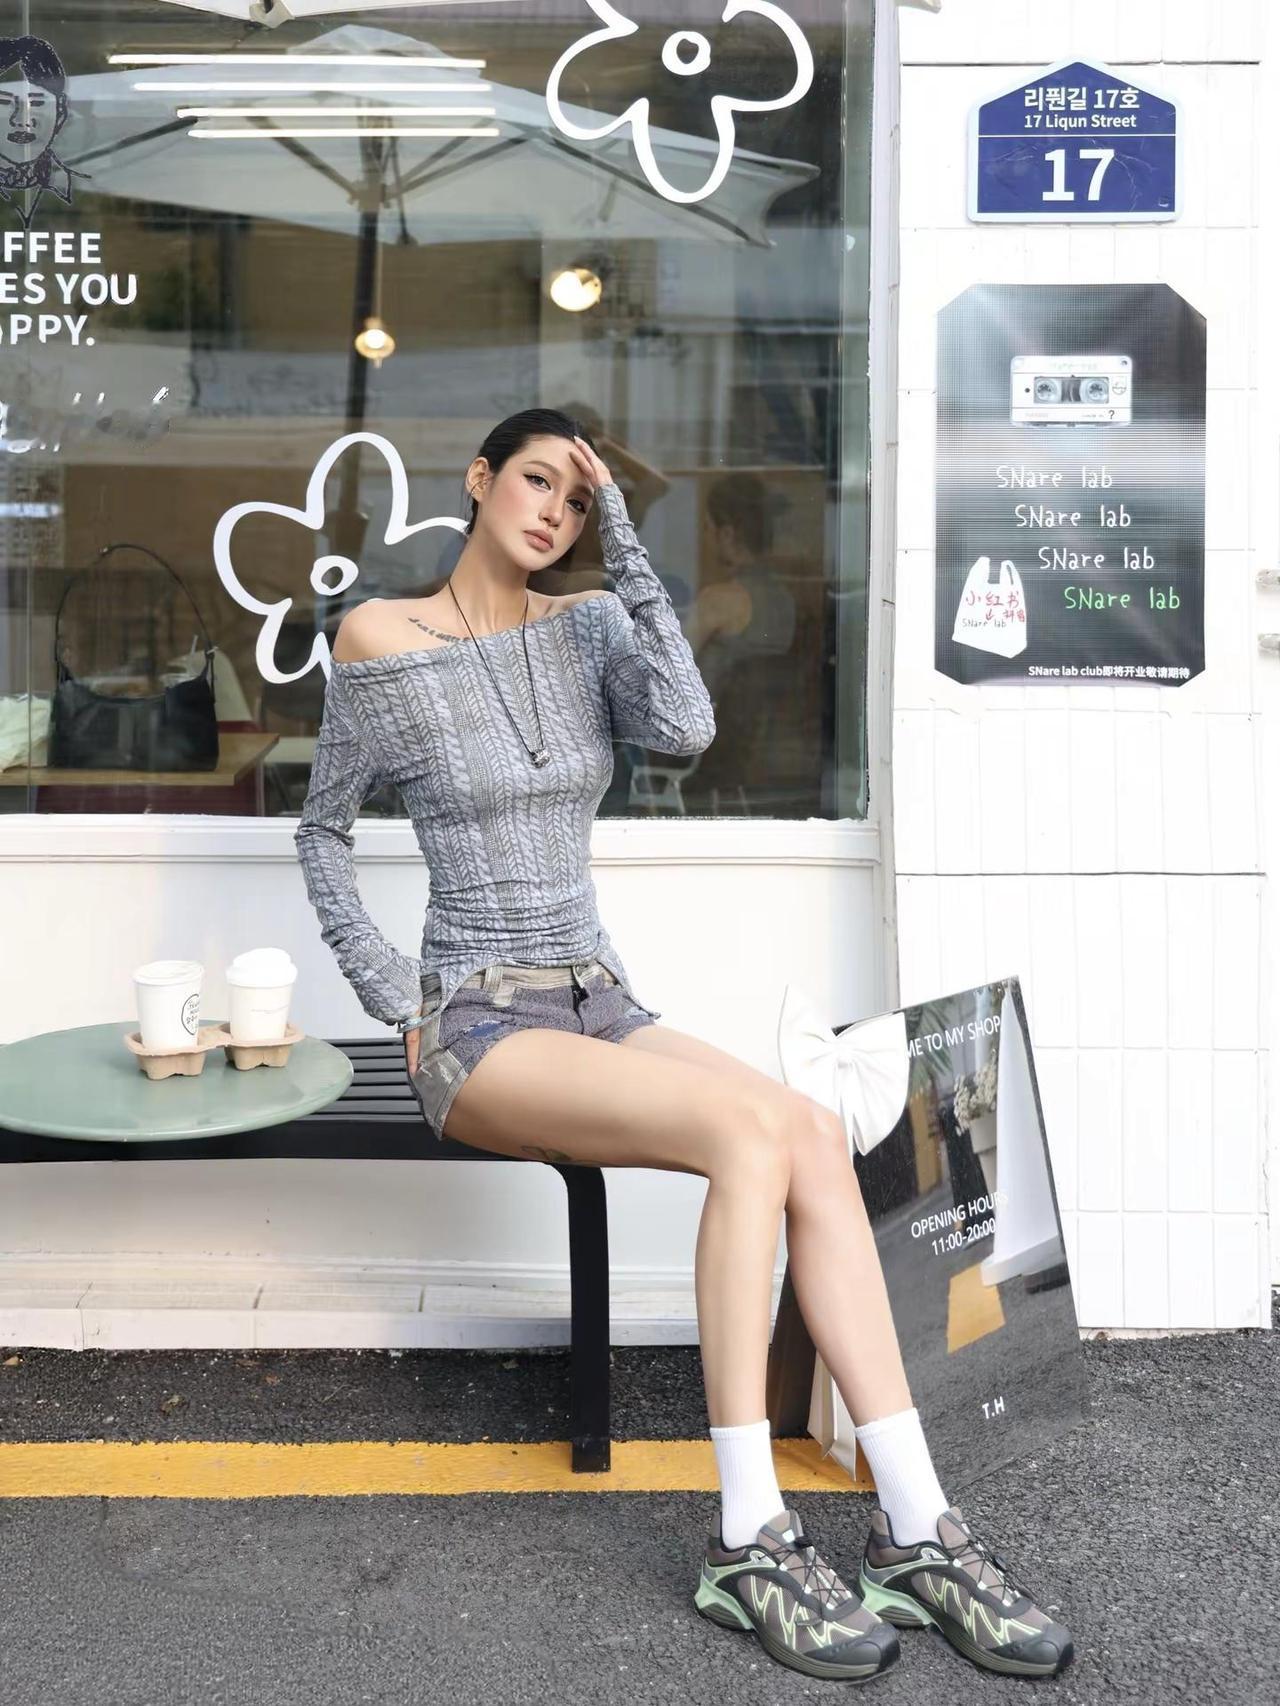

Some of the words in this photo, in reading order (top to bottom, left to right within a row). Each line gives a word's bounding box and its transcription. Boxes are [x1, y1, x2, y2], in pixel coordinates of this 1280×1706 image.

[1094, 86, 1141, 109] 17호
[1024, 115, 1042, 128] 17
[1045, 114, 1087, 131] Liqun
[1091, 114, 1137, 128] Street
[1042, 149, 1115, 202] 17
[4, 231, 101, 264] FFEE
[55, 273, 138, 305] YOU
[0, 313, 96, 347] PPY.
[995, 464, 1063, 488] SNare
[1081, 464, 1113, 488] lab
[1014, 504, 1081, 528] SNare
[1100, 504, 1131, 528] lab
[1038, 546, 1105, 570] SNare
[1123, 546, 1155, 570] lab
[965, 590, 1020, 609] 小红书
[1064, 586, 1131, 610] SNare
[1149, 586, 1180, 609] lab
[1028, 665, 1060, 677] SNare
[1061, 665, 1078, 677] lab
[924, 1032, 943, 1053] TO
[945, 1025, 965, 1047] MY
[967, 1015, 1001, 1040] SHOP
[911, 1204, 966, 1239] OPENING
[931, 1217, 997, 1256] 11:00-20:00
[981, 1395, 1006, 1420] T.H
